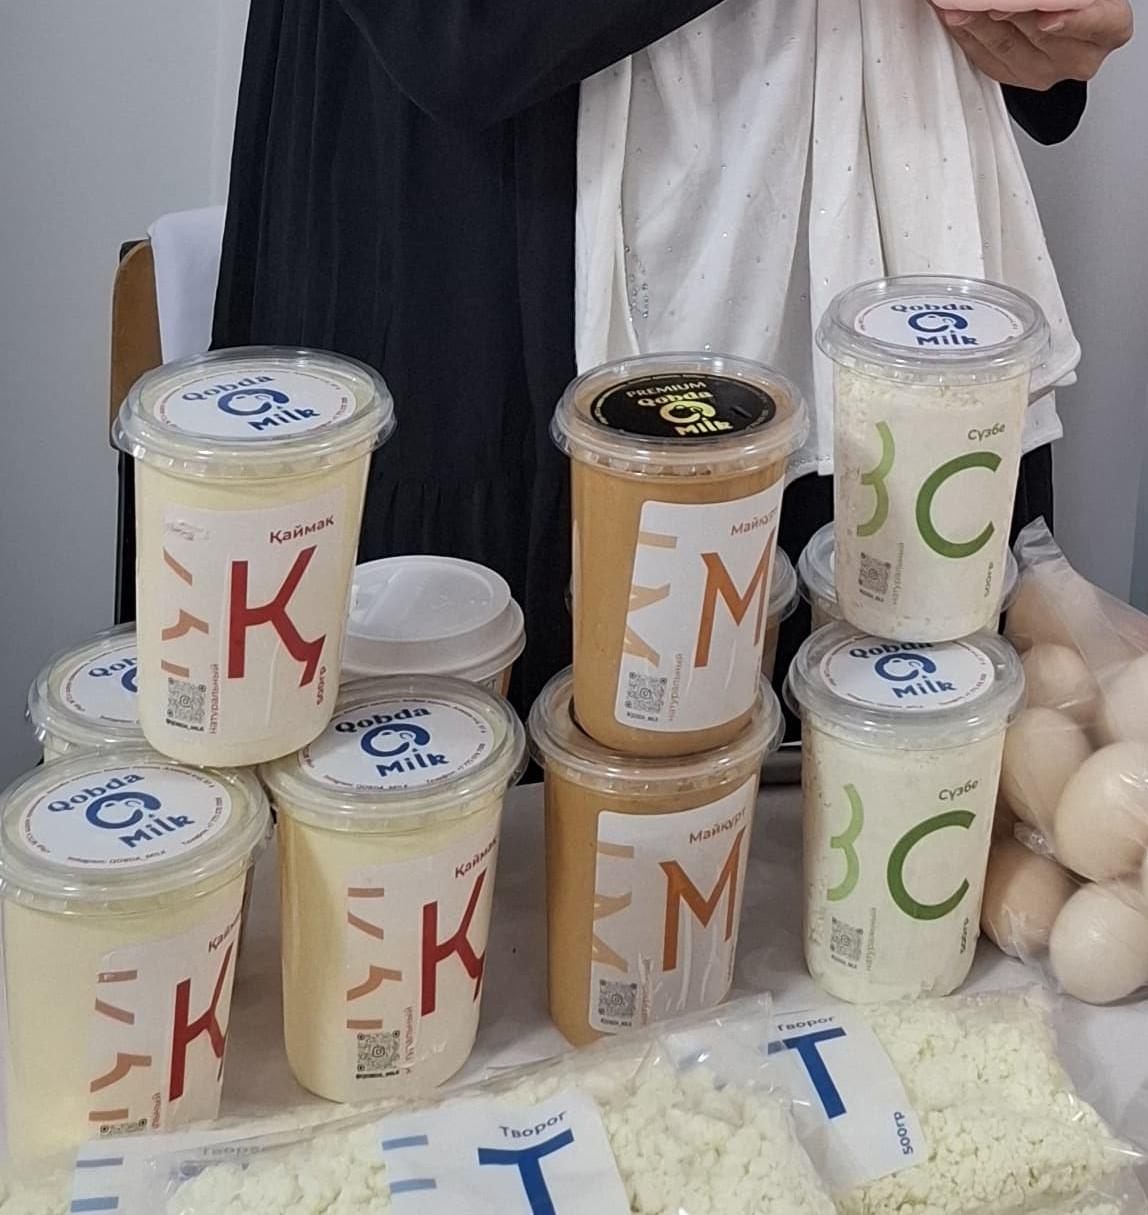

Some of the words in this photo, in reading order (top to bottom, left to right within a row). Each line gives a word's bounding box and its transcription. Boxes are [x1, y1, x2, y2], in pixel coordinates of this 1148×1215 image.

[890, 302, 974, 313] Qobda
[917, 330, 979, 346] Milk
[182, 373, 275, 401] Qobda
[626, 380, 706, 399] PREMIUM
[637, 389, 714, 408] Qobda
[247, 405, 320, 431] Milk
[675, 417, 734, 436] Milk
[892, 674, 958, 699] Milk
[335, 706, 432, 733] Qobda
[376, 747, 449, 777] Milk
[47, 773, 145, 812] Qobda
[119, 813, 195, 848] Milk
[777, 1016, 835, 1032] Творог
[498, 1110, 568, 1141] Творог
